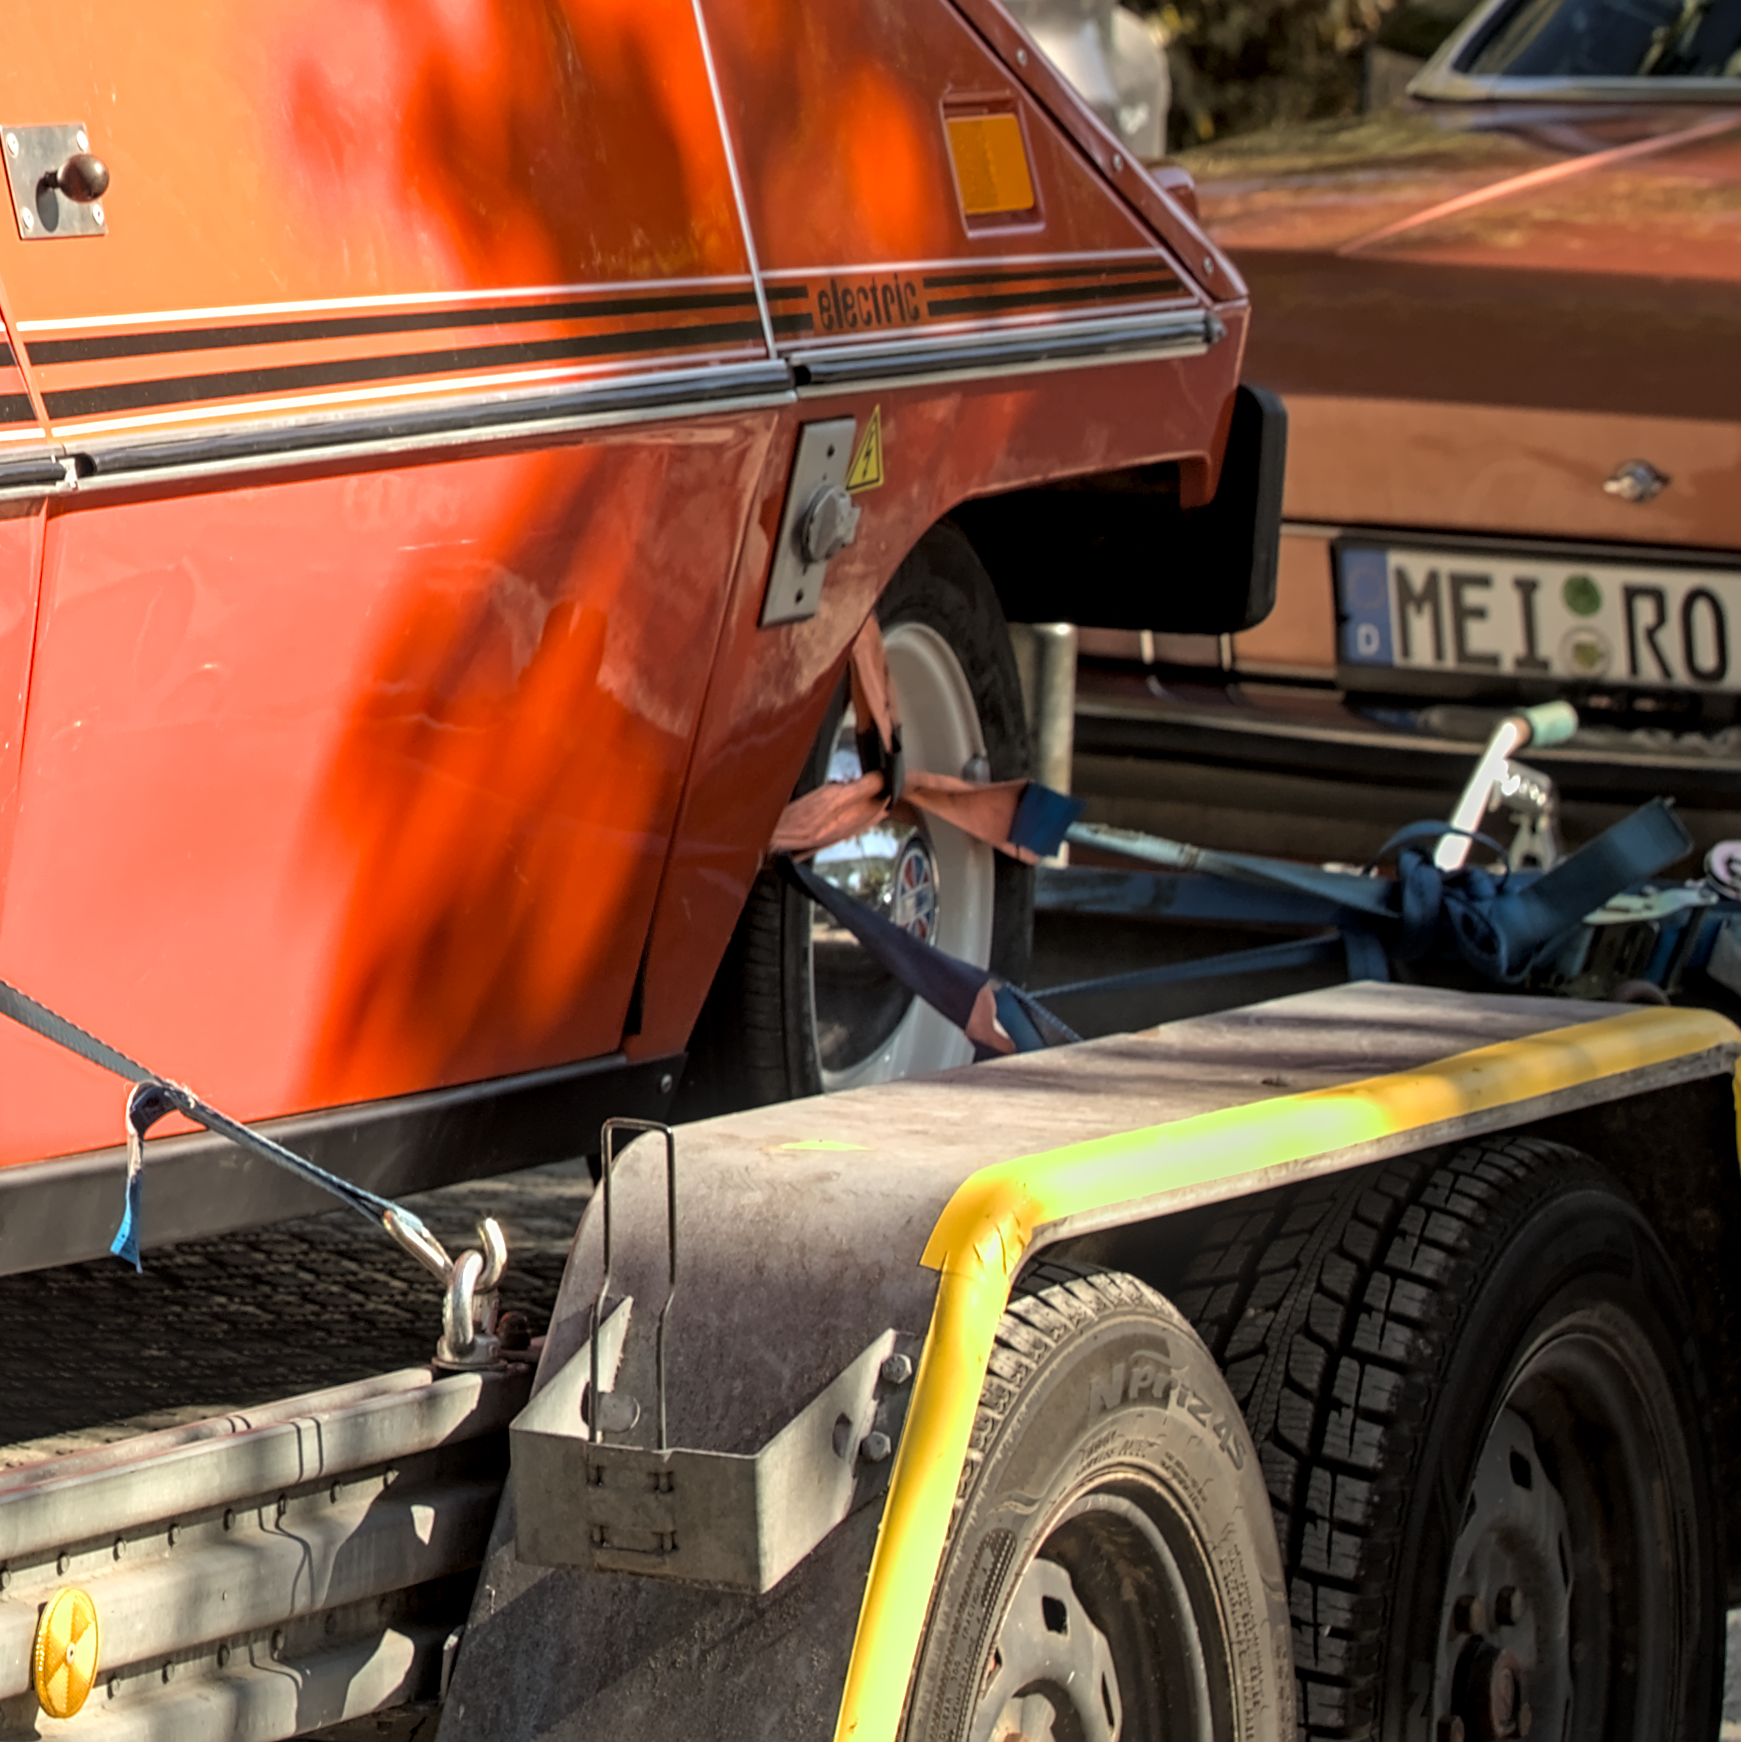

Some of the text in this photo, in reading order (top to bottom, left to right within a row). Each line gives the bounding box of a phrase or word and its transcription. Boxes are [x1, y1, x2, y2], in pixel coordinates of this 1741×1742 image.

[817, 272, 920, 331] electric
[1356, 566, 1730, 683] D MEI RO
